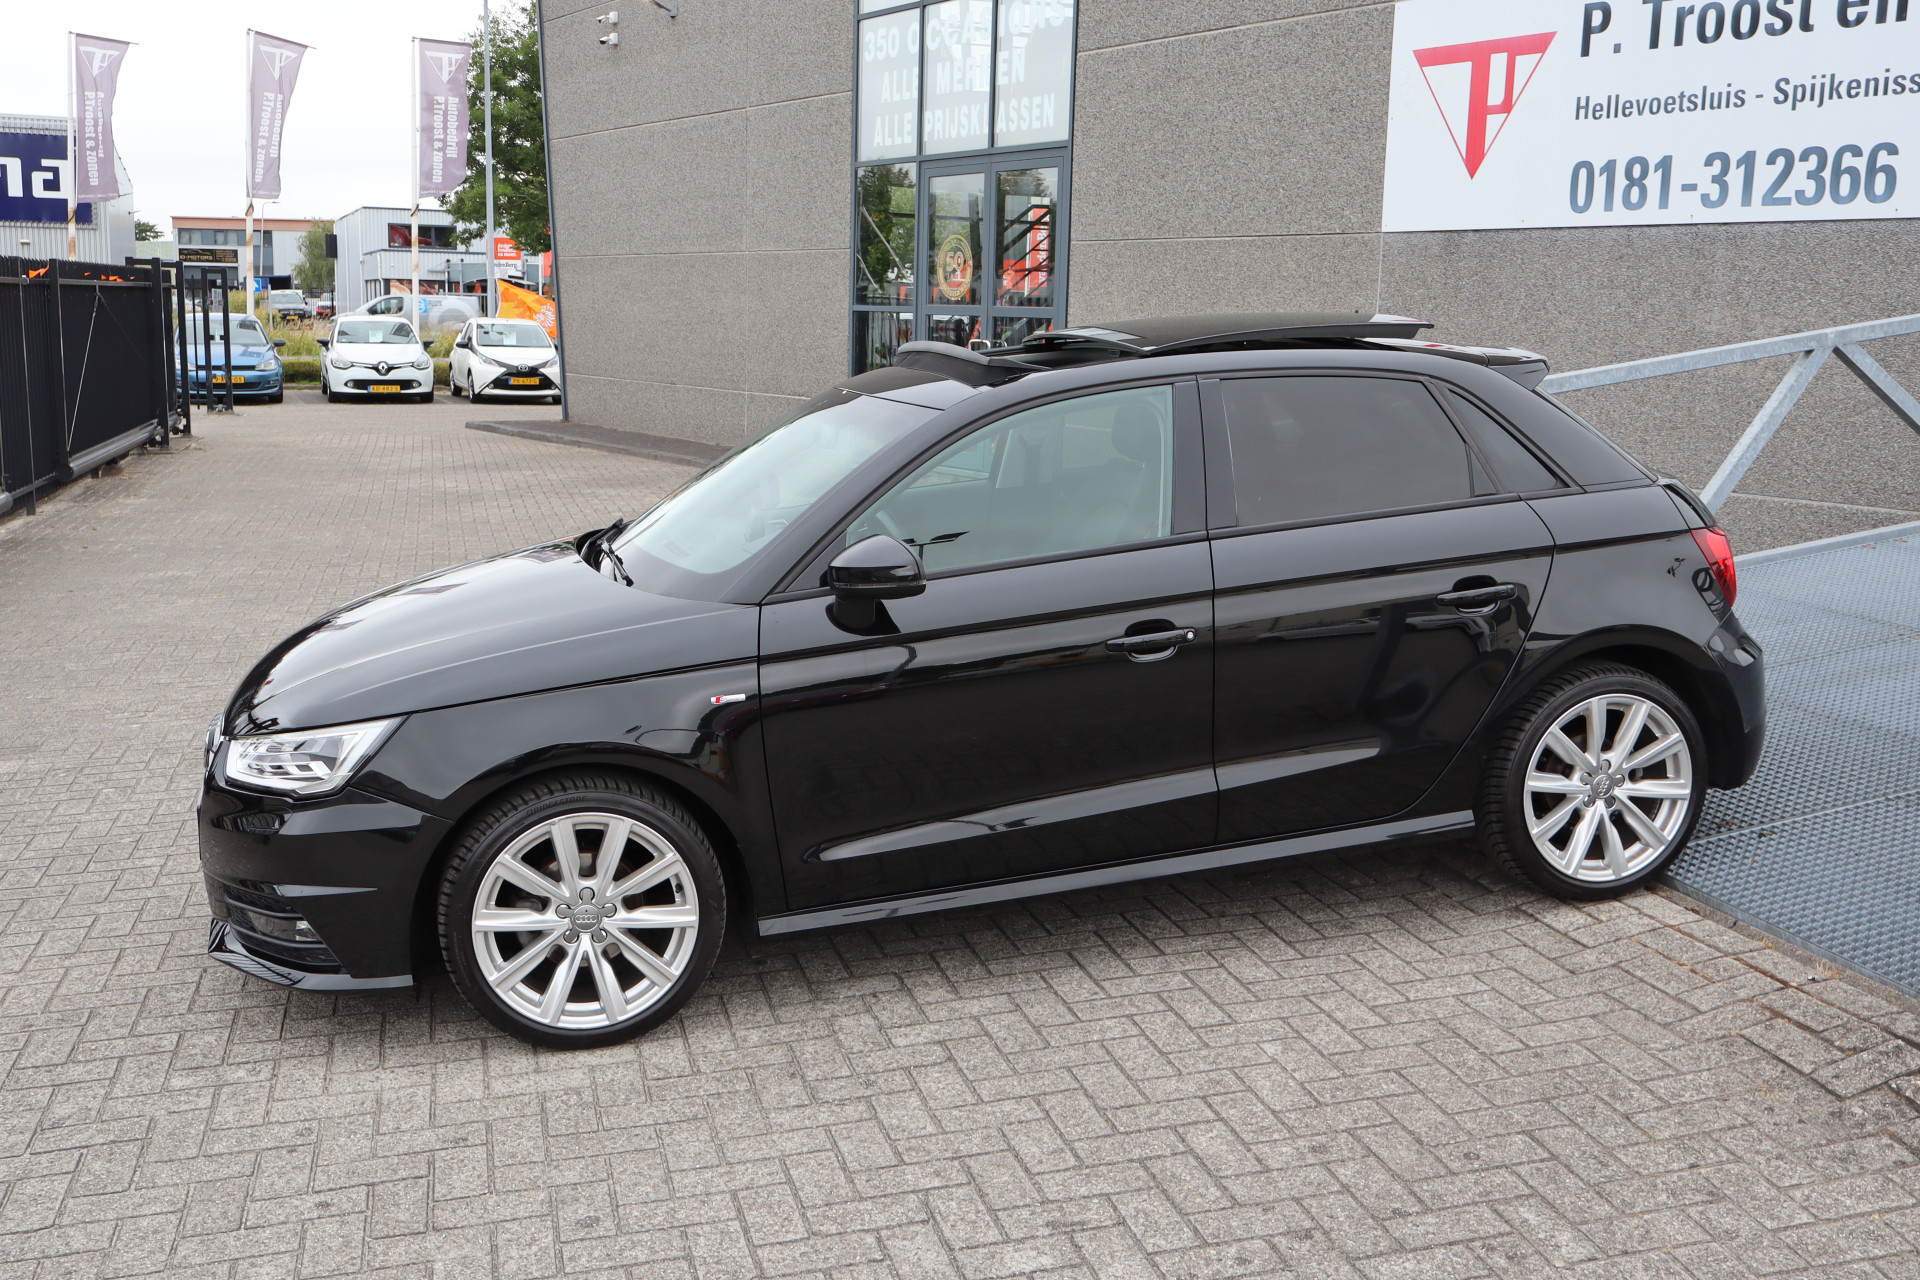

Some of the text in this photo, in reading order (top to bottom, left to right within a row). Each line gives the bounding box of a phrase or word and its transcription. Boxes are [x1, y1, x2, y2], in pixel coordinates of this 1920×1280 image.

[864, 26, 900, 62] 350
[1580, 1, 1622, 58] P.
[880, 67, 919, 103] ALLE
[1575, 83, 1746, 121] Hellevoetsluis
[446, 95, 459, 158] Autobedrijf
[873, 92, 1055, 147] ALLE PRIJSKLASSEN
[1569, 141, 1900, 214] 0181-312366
